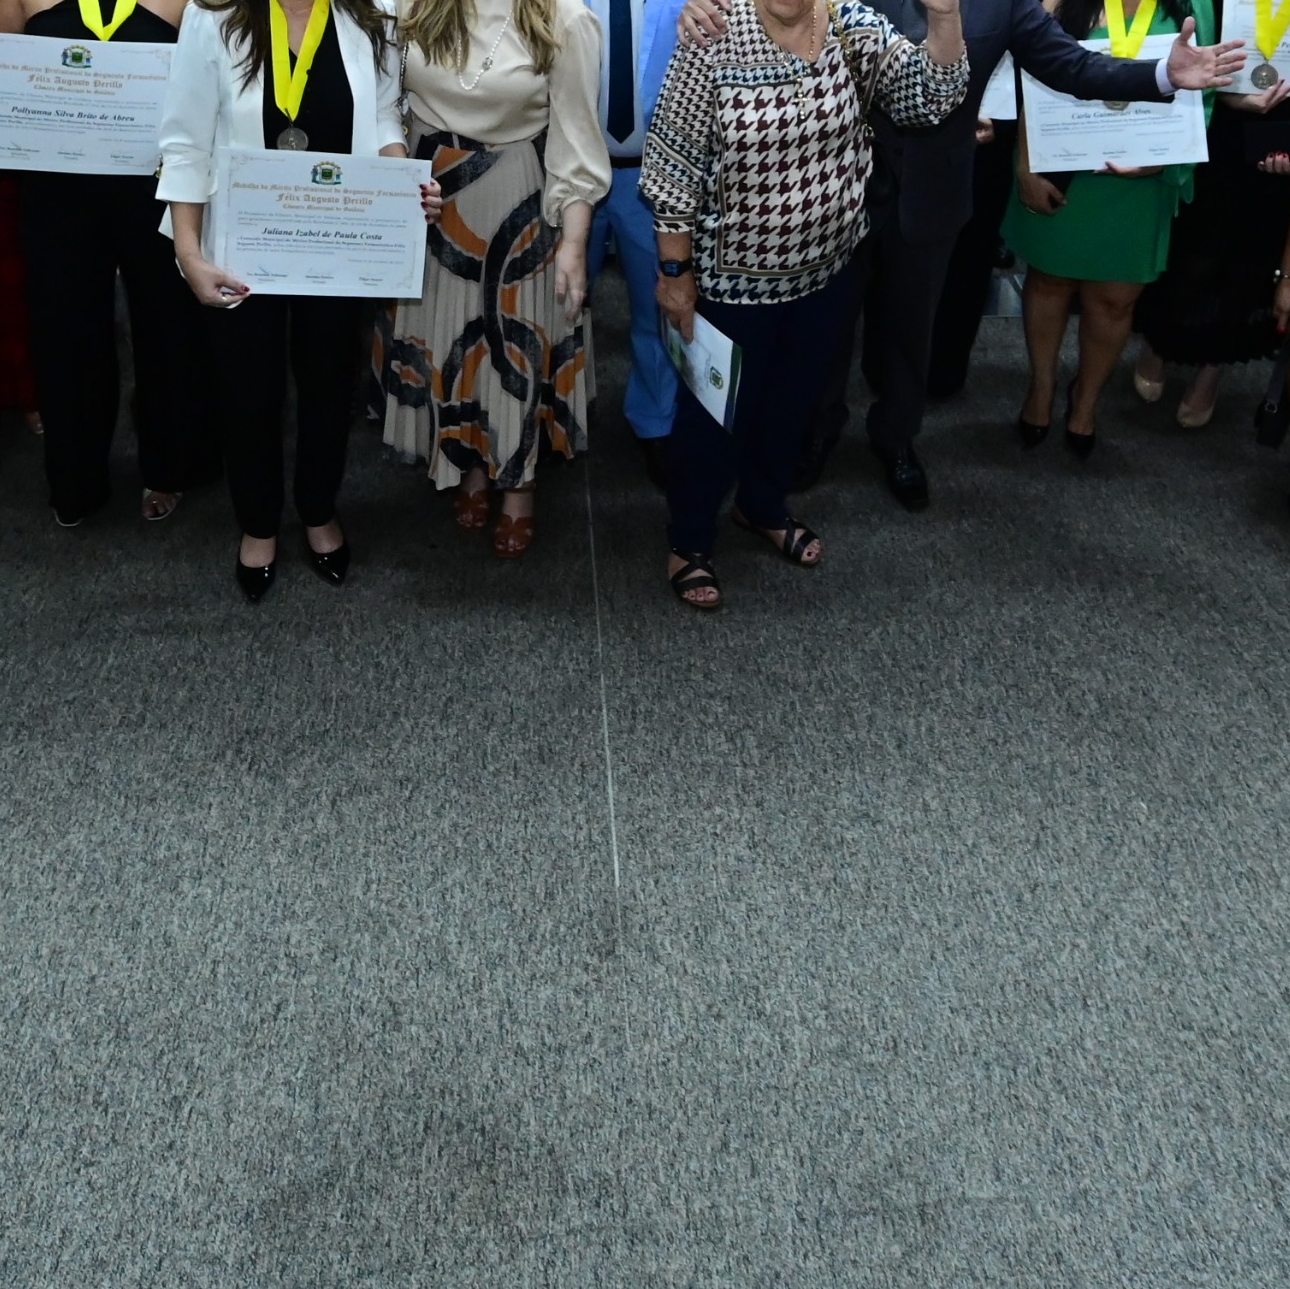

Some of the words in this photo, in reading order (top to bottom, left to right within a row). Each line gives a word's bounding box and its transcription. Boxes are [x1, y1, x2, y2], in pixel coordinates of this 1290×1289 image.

[26, 73, 50, 83] Félix
[54, 76, 89, 86] Augusto
[93, 79, 122, 89] Perillo
[11, 106, 51, 116] Pollyanna
[54, 109, 74, 117] Silva
[77, 111, 97, 119] Brito
[112, 113, 134, 121] Abreu
[275, 192, 300, 202] Félix
[304, 194, 338, 204] Augusto
[343, 196, 371, 205] Perillo
[261, 227, 293, 235] Juliana
[295, 229, 320, 237] Izabel
